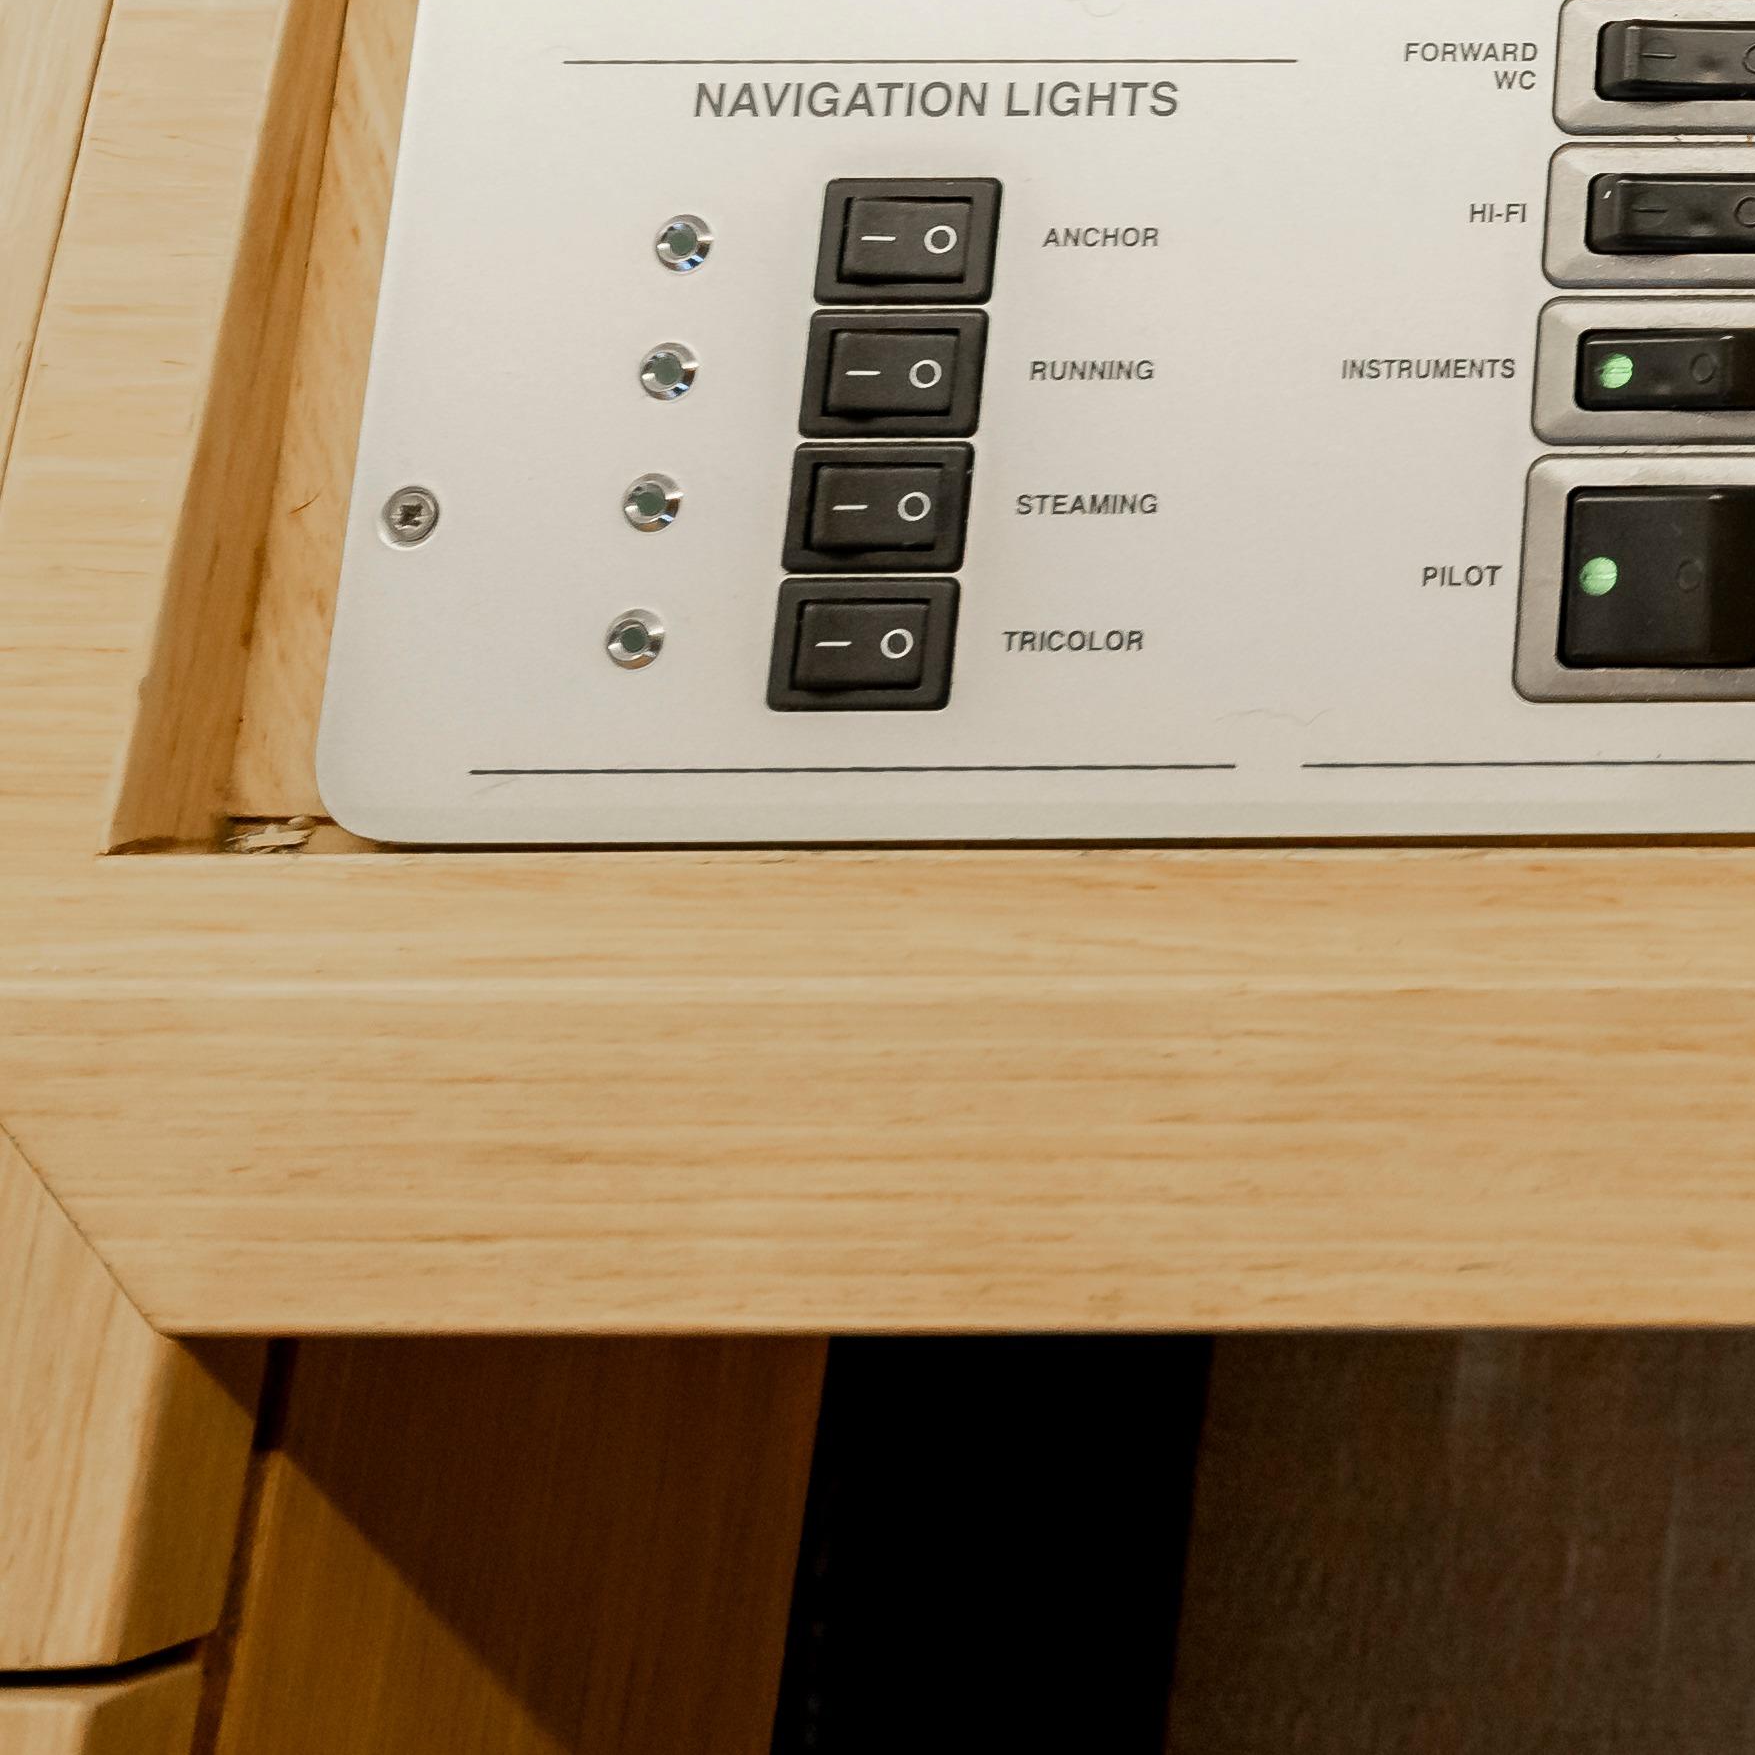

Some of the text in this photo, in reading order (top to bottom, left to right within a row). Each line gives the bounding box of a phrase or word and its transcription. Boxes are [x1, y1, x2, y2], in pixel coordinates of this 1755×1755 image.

[1404, 42, 1538, 62] FORWARD
[1493, 69, 1537, 91] WC
[693, 80, 1179, 118] NAVIGATION LIGHTS
[1469, 203, 1527, 223] HI-FI
[1041, 227, 1159, 248] ANCHOR
[1029, 359, 1154, 381] RUNNING
[1341, 358, 1516, 380] INSTRUMENTS
[1016, 493, 1158, 516] STEAMING
[1422, 565, 1503, 587] PILOT
[1001, 629, 1145, 652] TRICOLOR
